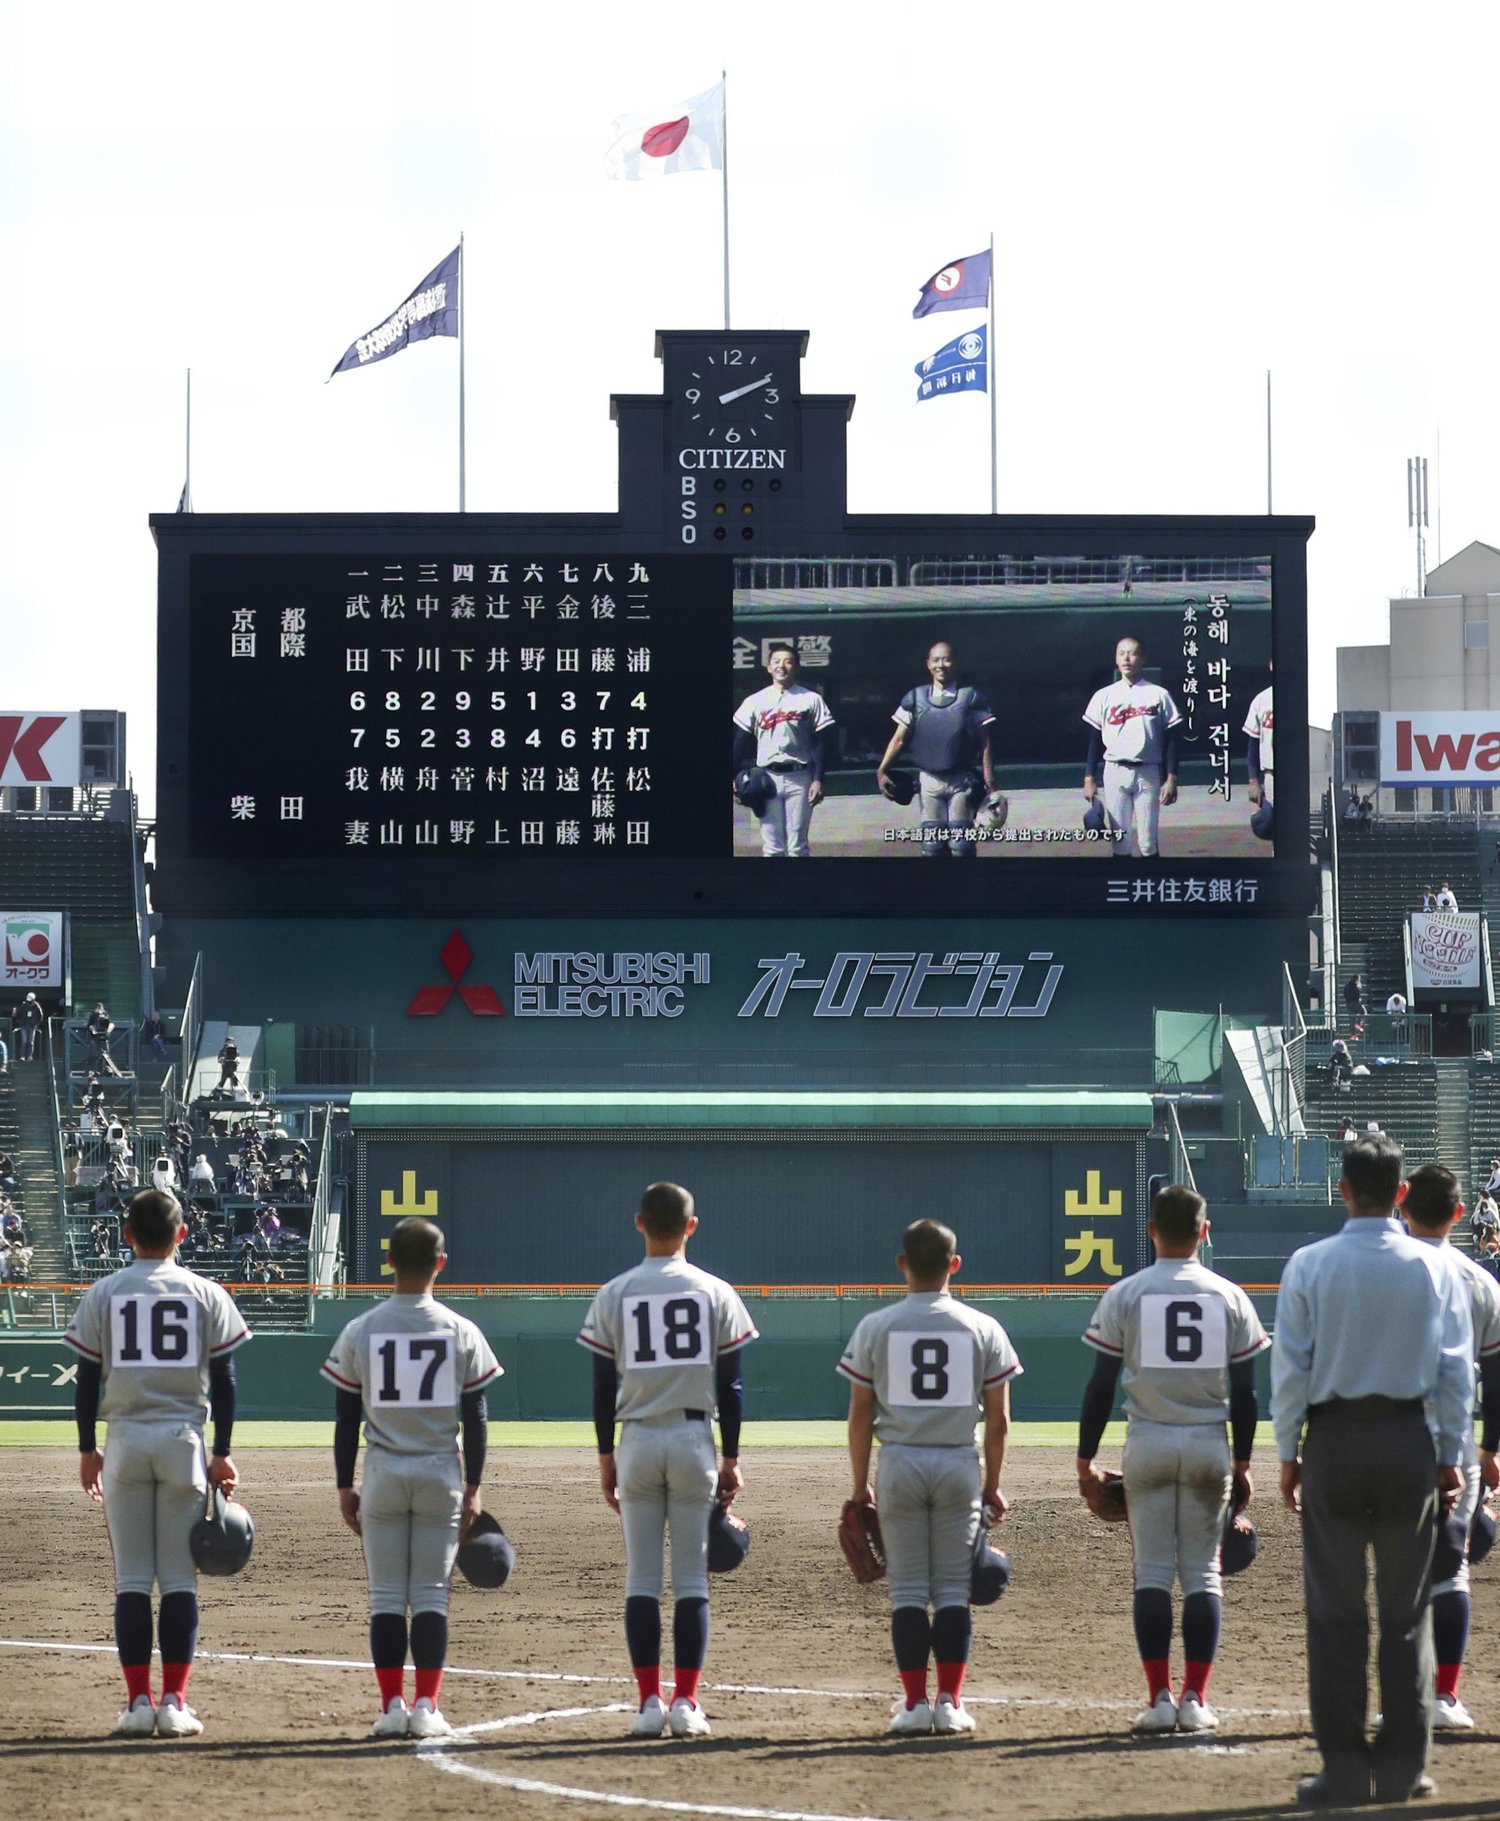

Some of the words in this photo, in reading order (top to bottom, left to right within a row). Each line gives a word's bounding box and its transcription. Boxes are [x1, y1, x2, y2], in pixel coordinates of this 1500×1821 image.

[724, 350, 742, 365] 12
[686, 389, 700, 404] 9
[765, 389, 779, 403] 3
[725, 428, 740, 443] 6
[679, 449, 785, 469] CITIZEN
[682, 477, 695, 495] B
[682, 501, 696, 519] S
[682, 525, 696, 543] O
[383, 566, 403, 580] 二
[418, 564, 438, 581] 三
[453, 564, 474, 582] 四
[488, 564, 508, 582] 五
[524, 564, 543, 582] 六
[559, 564, 578, 582] 七
[593, 563, 613, 582] 八
[628, 563, 649, 583] 九
[1205, 592, 1230, 646] 동해
[1205, 658, 1231, 711] 바다
[351, 692, 365, 710] 6
[385, 692, 400, 710] 8
[421, 692, 435, 710] 2
[456, 692, 470, 710] 9
[491, 692, 505, 710] 5
[527, 692, 535, 710] 1
[561, 691, 576, 710] 3
[597, 692, 610, 710] 7
[631, 692, 646, 710] 4
[351, 729, 364, 747] 7
[386, 729, 400, 747] 5
[421, 729, 435, 747] 2
[456, 729, 470, 747] 3
[491, 729, 505, 747] 8
[526, 729, 541, 747] 4
[561, 729, 576, 747] 6
[592, 727, 614, 750] 打
[627, 727, 649, 750] 打
[1395, 719, 1500, 773] Iwa
[1205, 722, 1231, 802] 건너서
[881, 825, 1128, 844] 日本語訳は学校から提出されたものです
[1107, 878, 1258, 902] 三井住友銀行
[5, 967, 50, 980] オークワ
[512, 950, 710, 986] MITSUBISHI
[736, 950, 1064, 1017] オーロラビジョン
[512, 984, 686, 1019] ELECTRIC
[1063, 1169, 1123, 1277] 山九
[118, 1299, 189, 1361] 16
[631, 1297, 702, 1363] 18
[1164, 1300, 1203, 1362] 6
[377, 1338, 447, 1402] 17
[909, 1337, 949, 1401] 8
